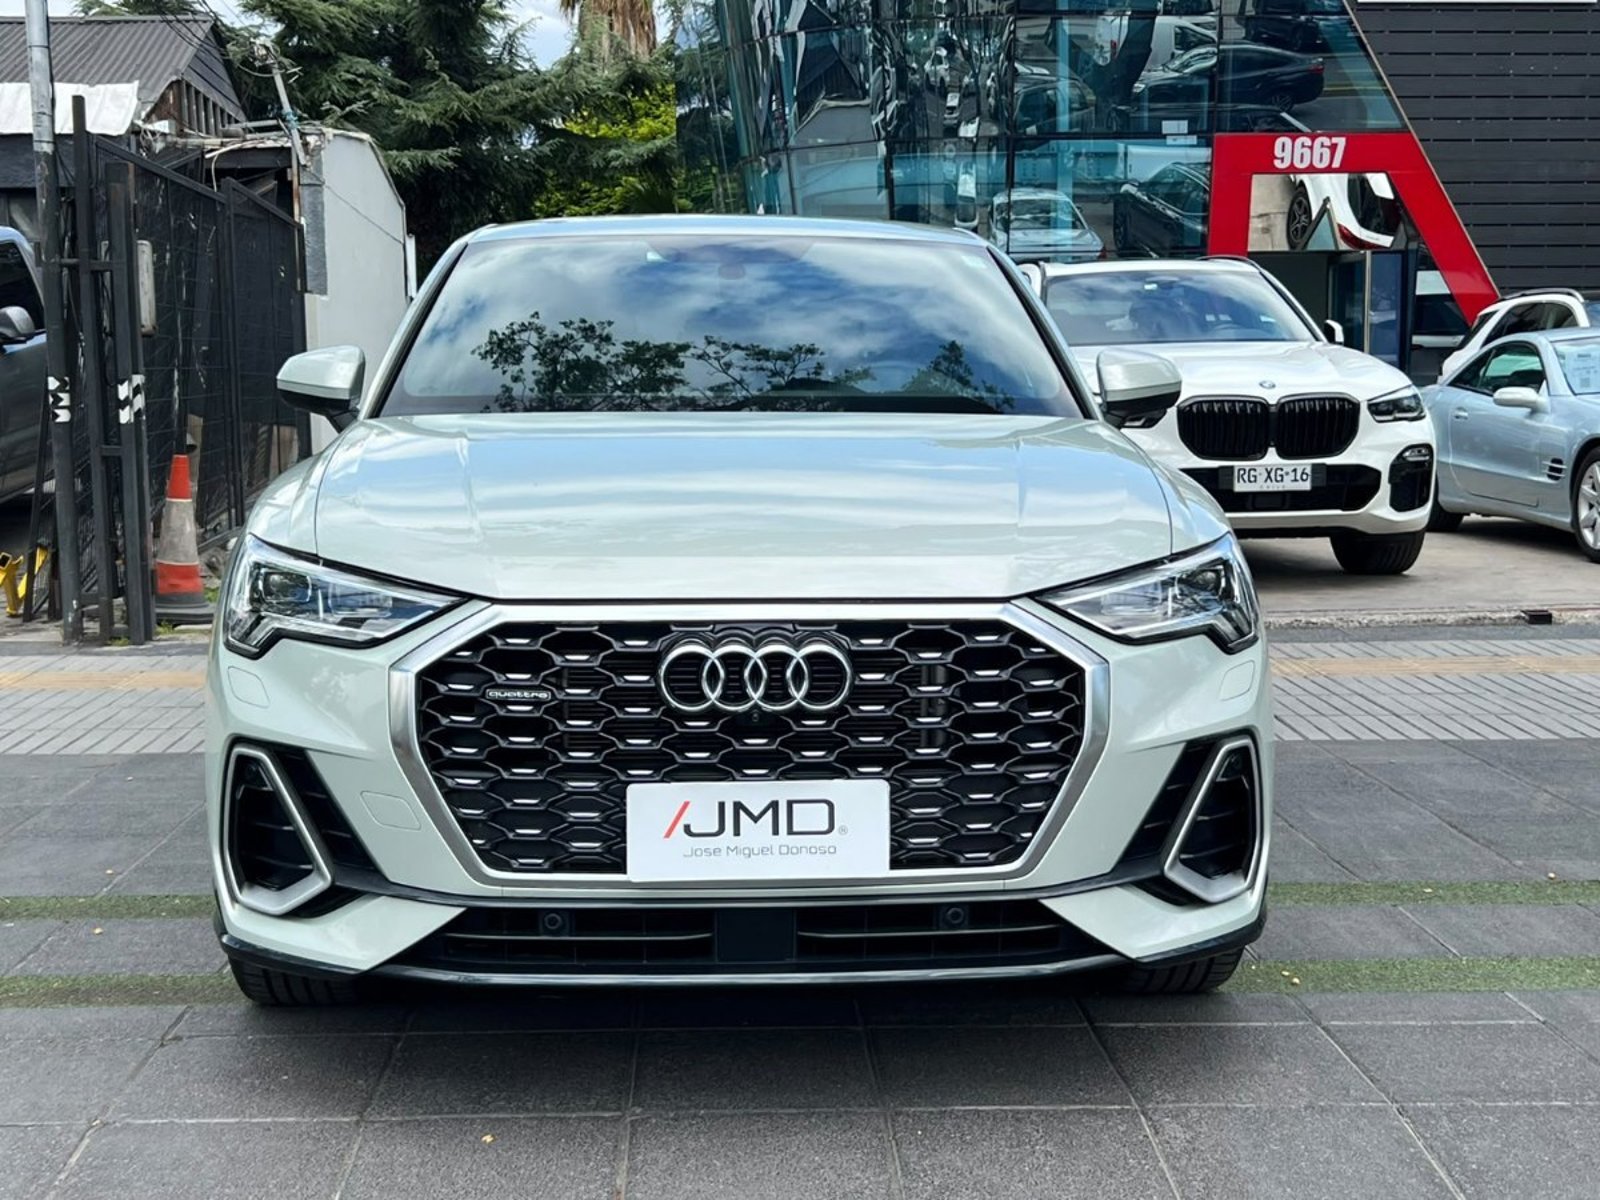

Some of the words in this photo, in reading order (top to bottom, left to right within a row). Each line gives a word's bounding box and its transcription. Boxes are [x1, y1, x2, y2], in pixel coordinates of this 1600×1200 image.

[1273, 136, 1347, 169] 9667
[488, 690, 549, 699] quattro
[683, 846, 722, 858] Jose
[726, 845, 774, 859] Miguel
[778, 844, 837, 856] Donoso
